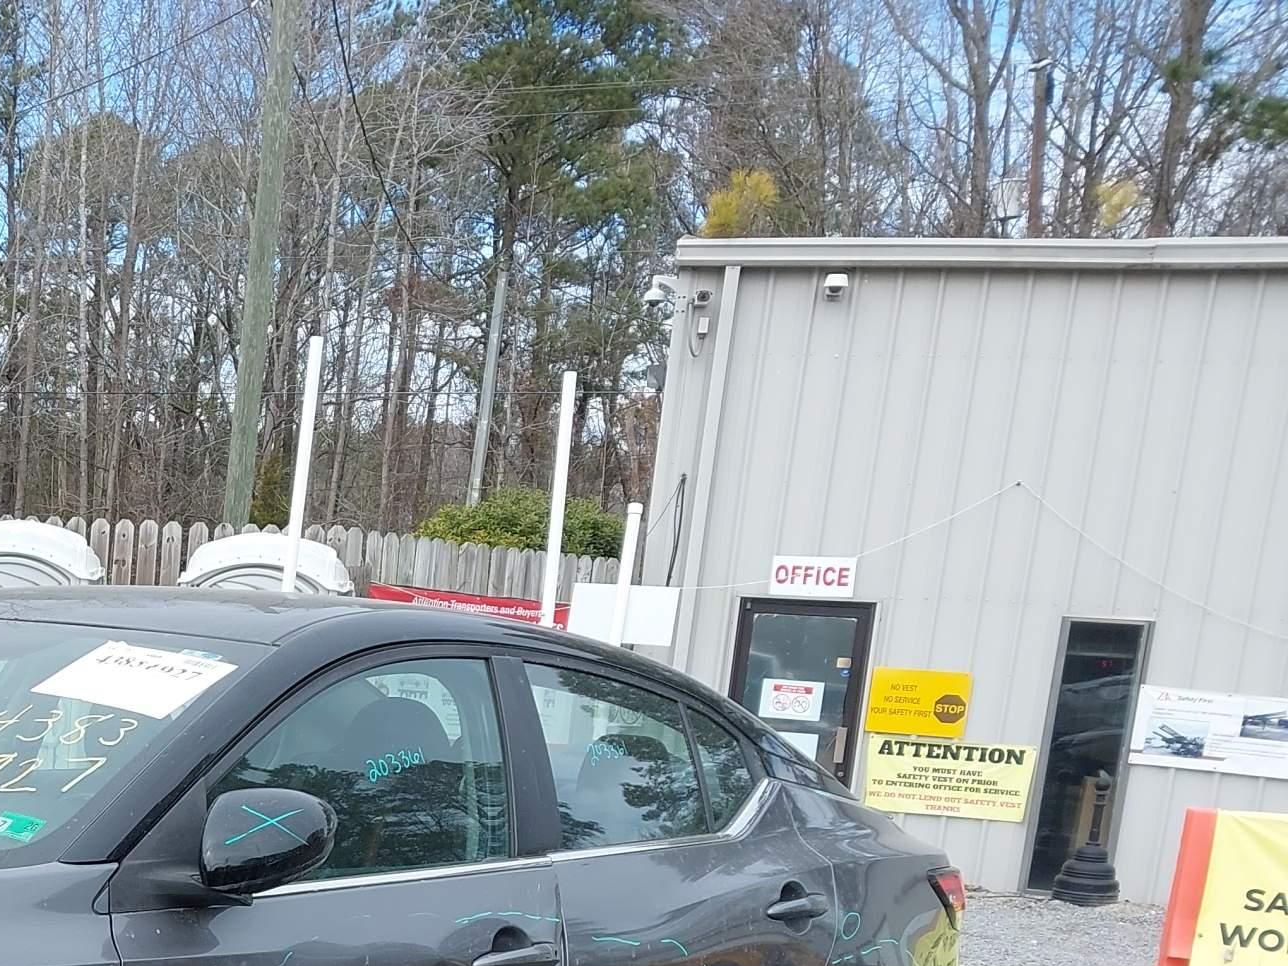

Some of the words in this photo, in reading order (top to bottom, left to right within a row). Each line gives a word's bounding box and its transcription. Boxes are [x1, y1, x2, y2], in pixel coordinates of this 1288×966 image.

[775, 564, 851, 587] OFFICE
[413, 596, 449, 609] Attention
[450, 599, 499, 615] Transporters
[500, 605, 516, 615] and
[902, 684, 918, 692] VEST
[894, 697, 921, 705] SERVICE
[935, 703, 964, 714] STOP
[870, 707, 887, 715] YOUR
[888, 708, 912, 716] SAFETY
[913, 710, 933, 718] FIRST
[878, 739, 1027, 765] ATTENTION
[366, 745, 426, 783] 203361
[932, 767, 957, 775] MUST
[960, 769, 983, 777] HAVE
[885, 779, 931, 790] ENTERING
[933, 783, 962, 792] OFFICE
[964, 786, 981, 794] FOR
[983, 787, 1020, 797] SERVICE
[897, 773, 928, 782] SAFETY
[932, 775, 953, 783] VEST
[956, 777, 969, 785] ON
[971, 778, 998, 787] PRIOR
[869, 790, 882, 798] WE
[898, 792, 917, 800] NOT
[919, 794, 943, 803] LEND
[944, 796, 962, 804] OUT
[963, 797, 998, 807] SAFETY
[999, 800, 1023, 809] VEST
[925, 804, 961, 813] THANKS
[1220, 922, 1288, 955] WO
